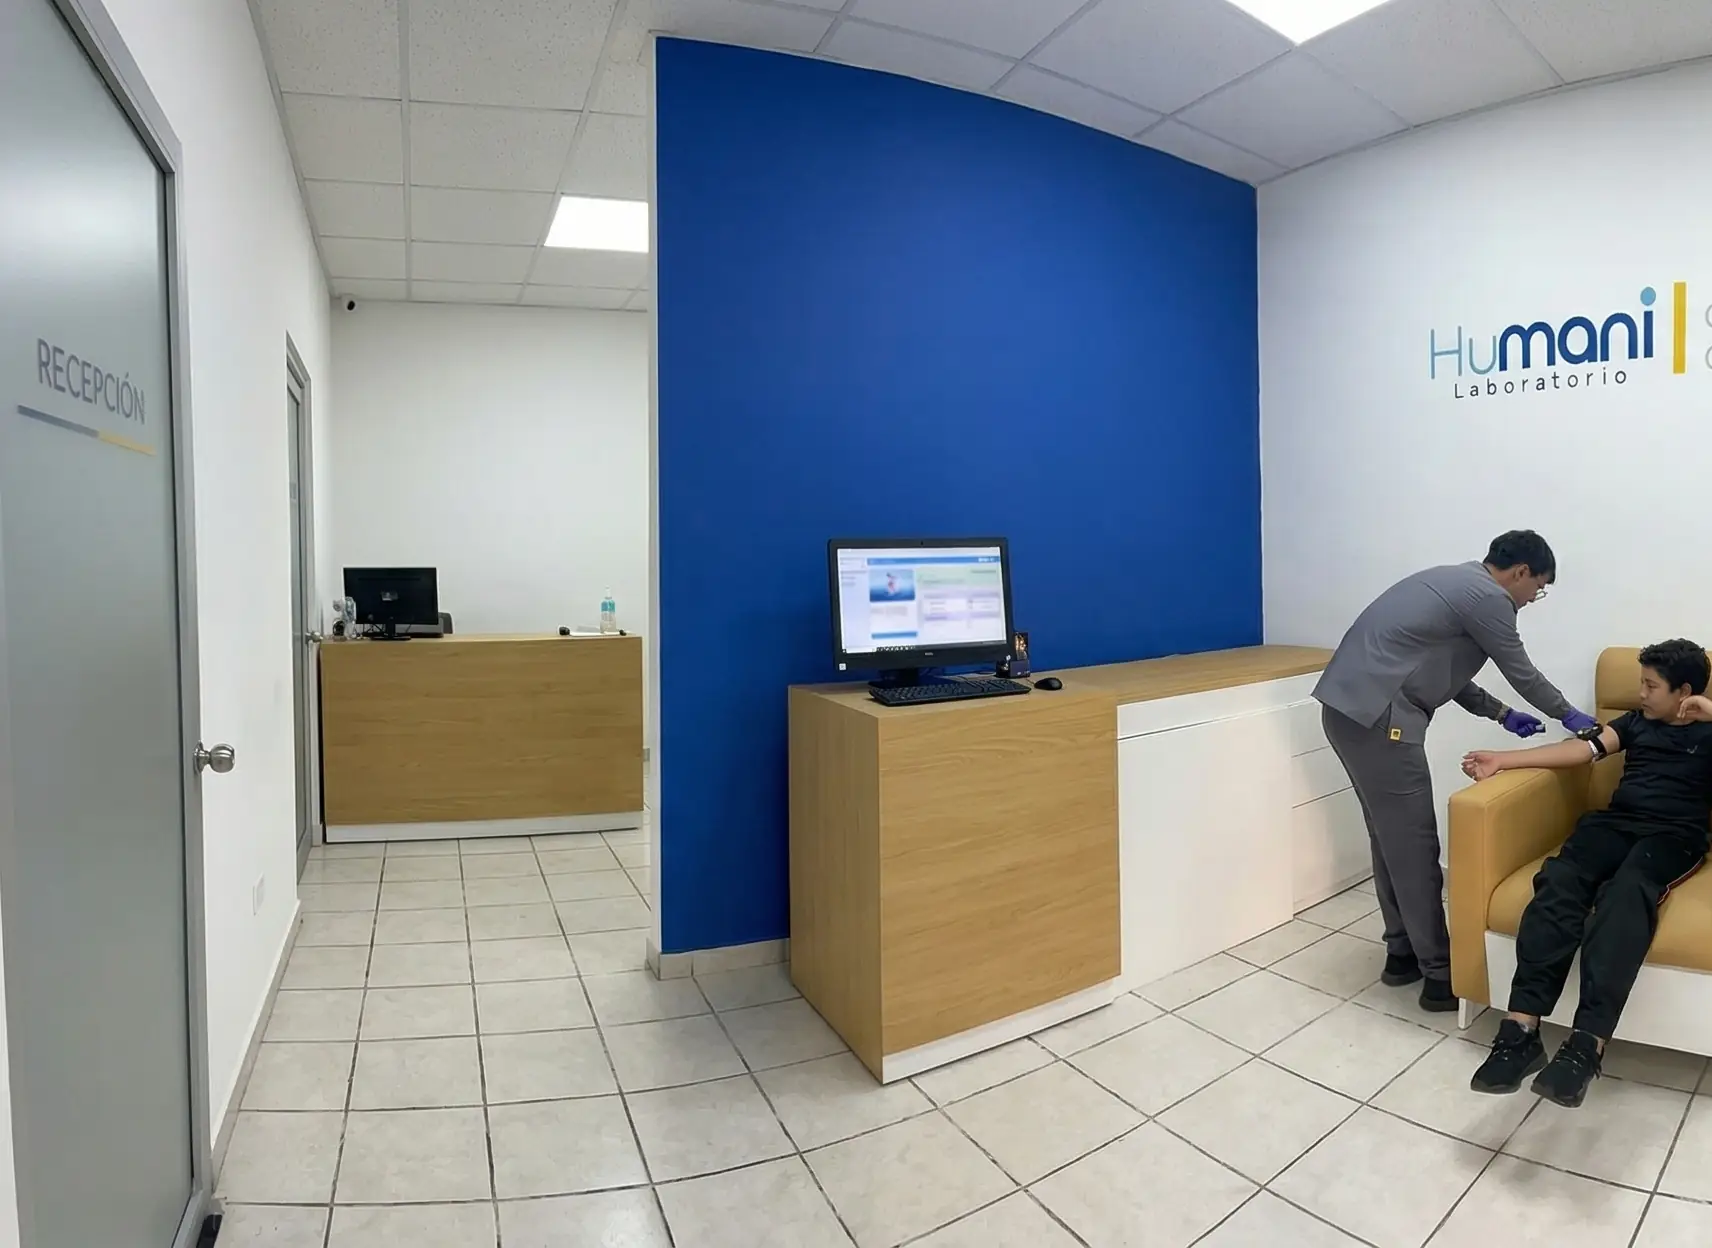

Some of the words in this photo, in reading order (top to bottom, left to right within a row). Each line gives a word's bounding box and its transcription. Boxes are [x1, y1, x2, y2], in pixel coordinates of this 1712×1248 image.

[1429, 286, 1657, 380] Humani
[37, 337, 146, 425] RECEPCIÓN
[1453, 367, 1627, 399] Laboratorio
